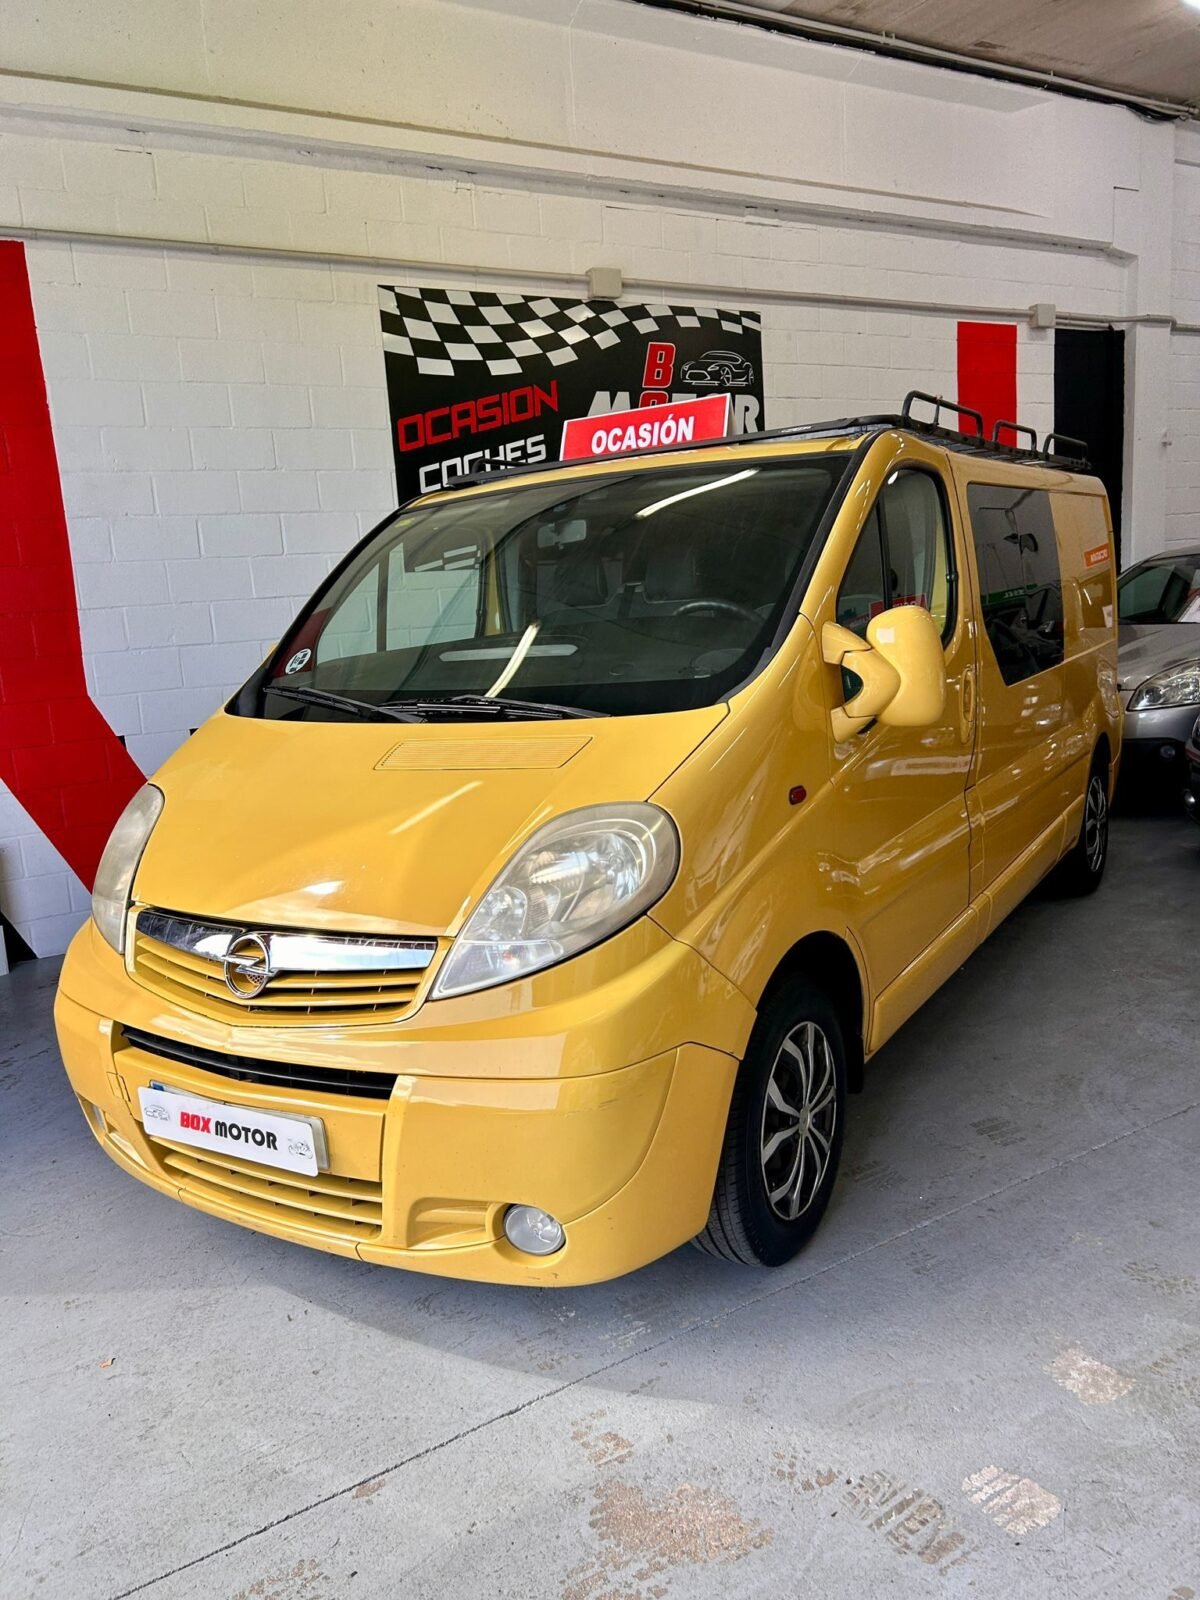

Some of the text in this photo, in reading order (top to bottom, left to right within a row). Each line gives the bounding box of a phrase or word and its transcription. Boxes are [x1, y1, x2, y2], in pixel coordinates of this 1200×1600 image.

[397, 379, 559, 452] OCASION
[591, 413, 695, 455] OCASIÓN
[179, 1111, 278, 1151] BOX MOTOR
